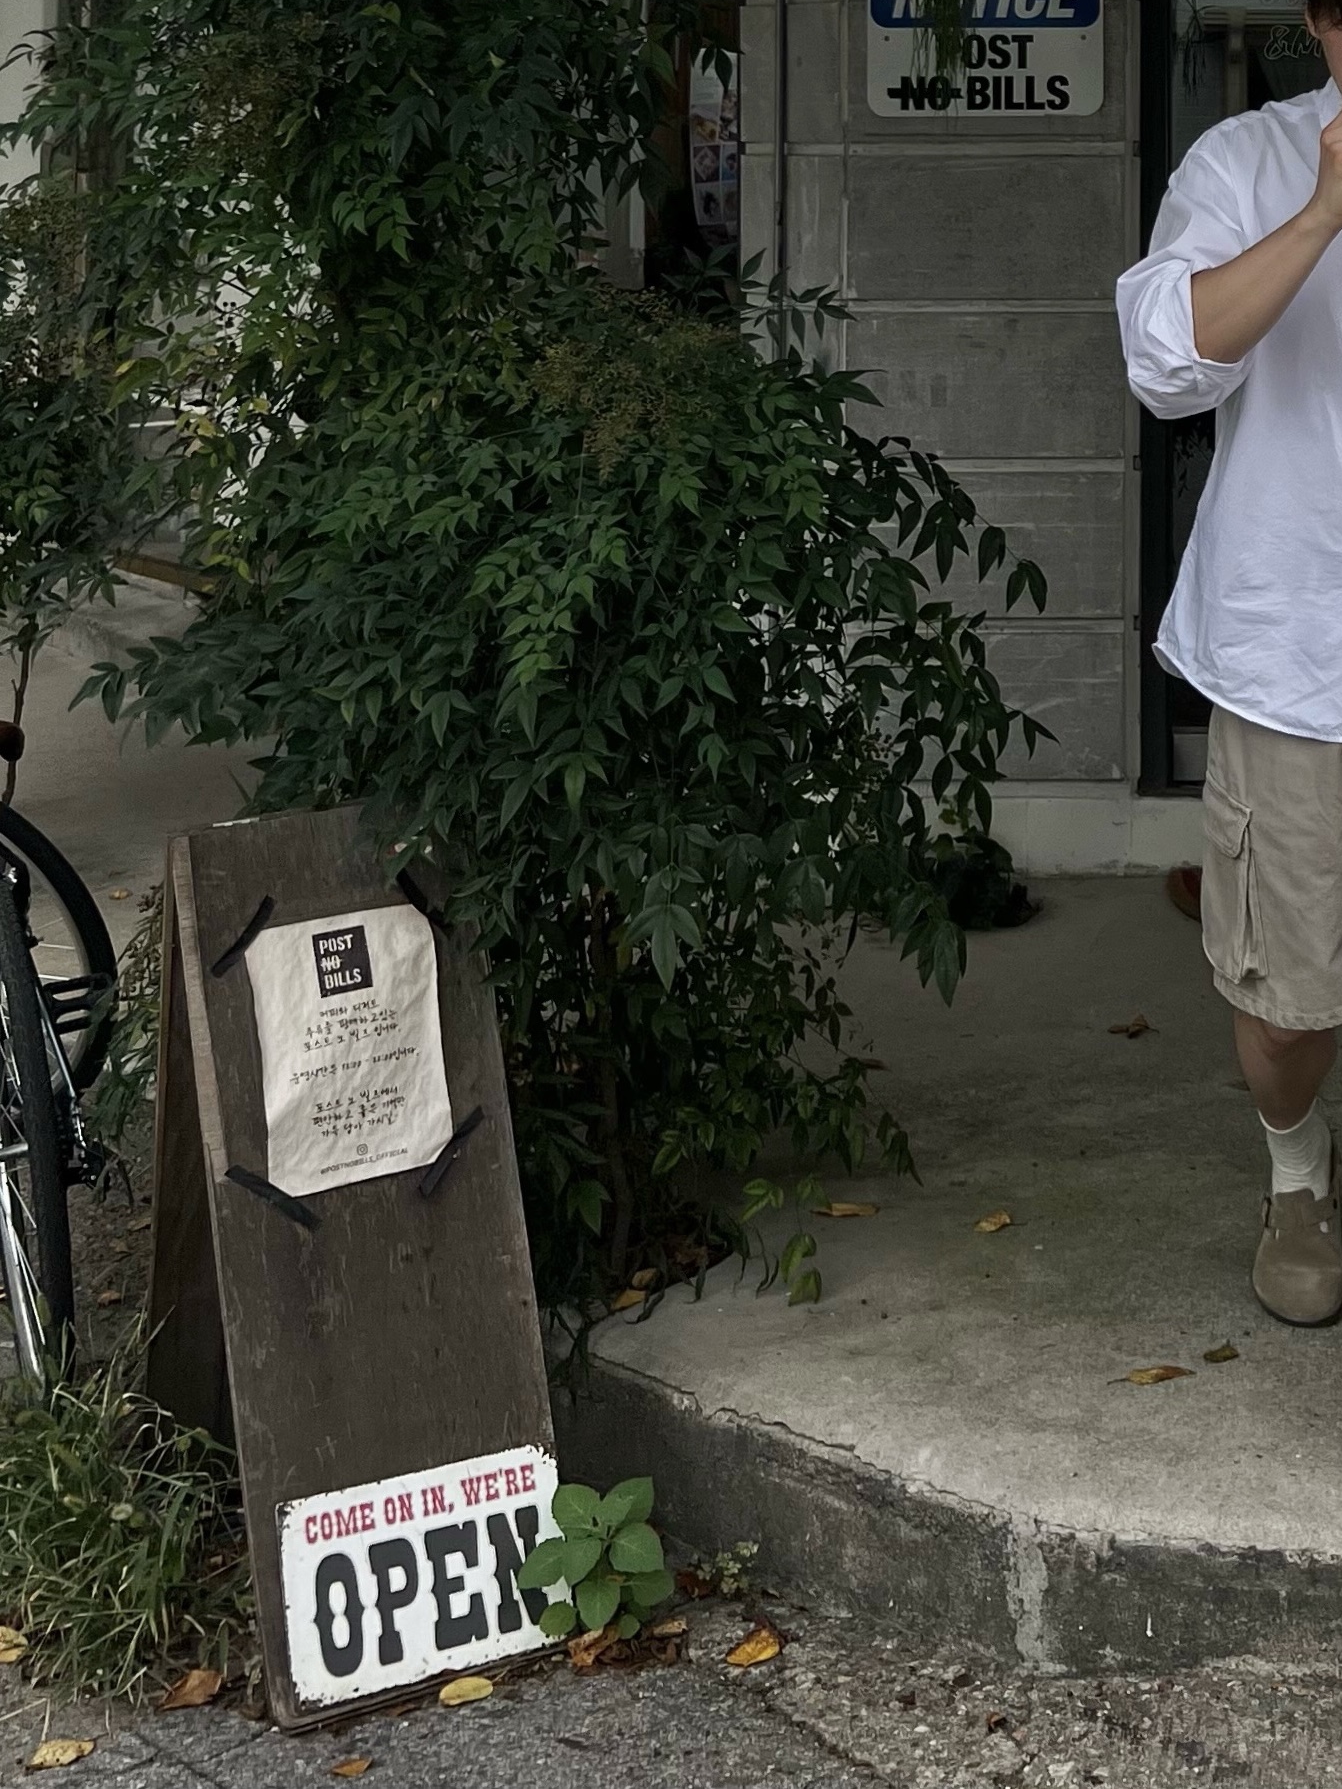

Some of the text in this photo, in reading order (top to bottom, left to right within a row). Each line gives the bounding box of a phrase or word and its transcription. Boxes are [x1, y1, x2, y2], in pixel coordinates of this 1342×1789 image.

[945, 34, 1034, 70] OST
[900, 75, 1070, 111] NO BILLS
[318, 934, 353, 955] POST
[321, 955, 342, 972] NO
[324, 968, 362, 989] BILLS
[305, 1463, 537, 1545] COME ON IN, WE'RE
[313, 1505, 550, 1678] OPEN
